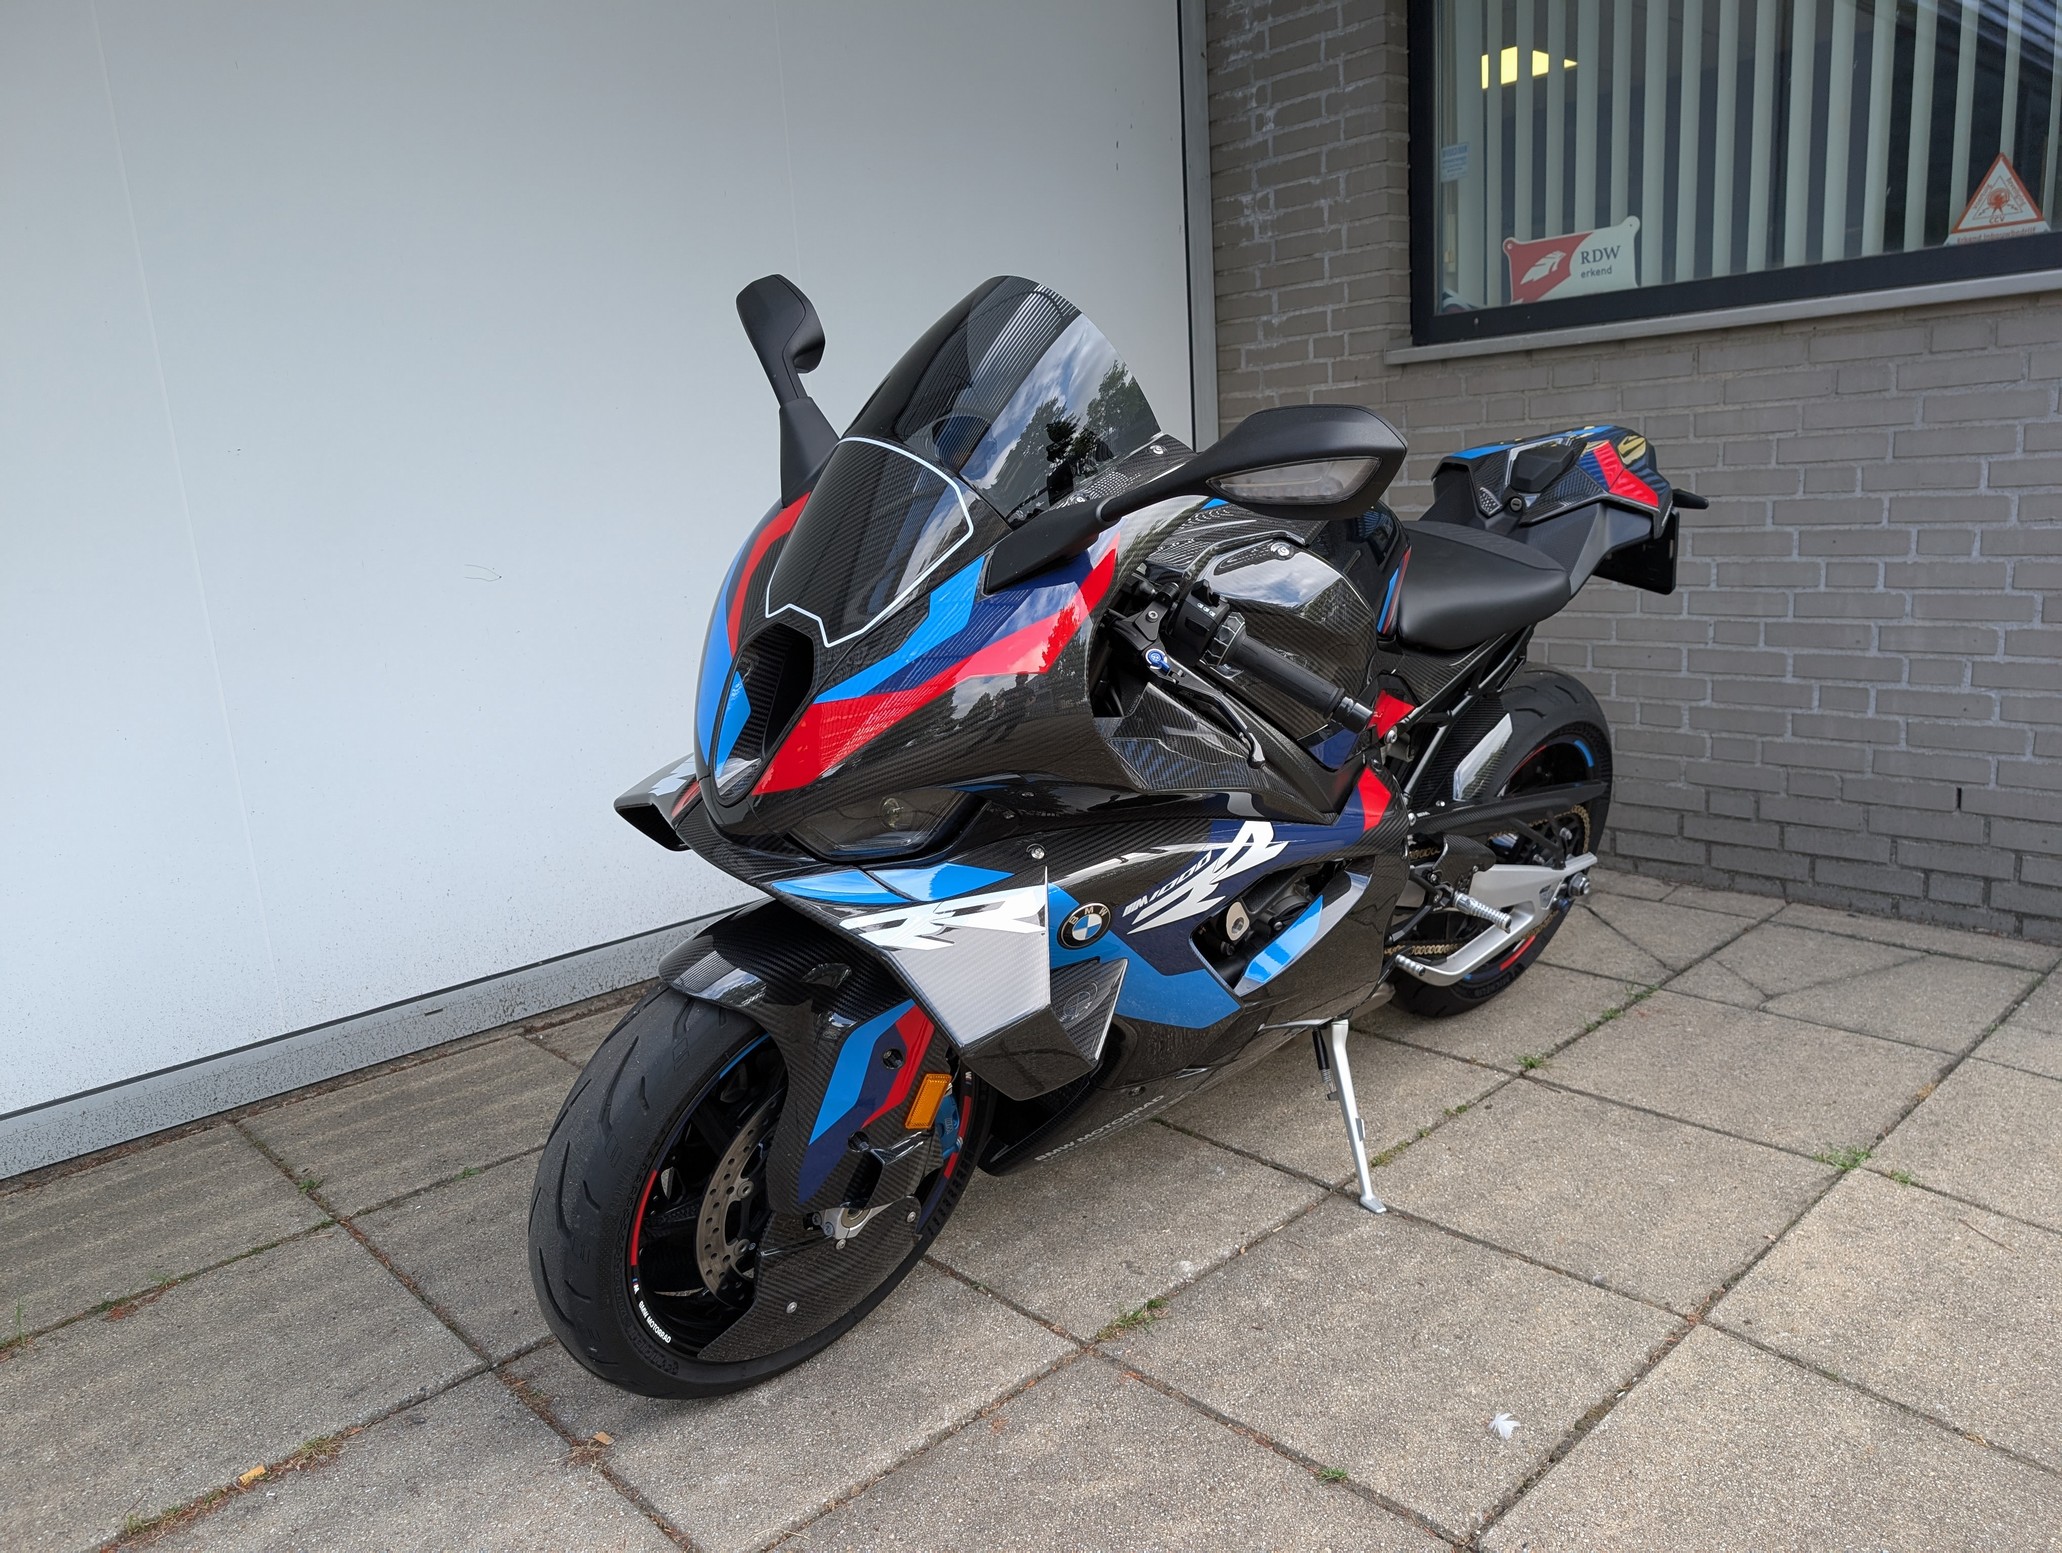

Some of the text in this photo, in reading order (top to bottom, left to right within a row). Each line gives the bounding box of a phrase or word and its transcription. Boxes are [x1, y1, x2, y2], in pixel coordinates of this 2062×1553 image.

[1580, 245, 1621, 265] RDW
[1580, 265, 1613, 279] erkend
[1034, 1095, 1165, 1161] BMW MOTORRAD
[638, 1300, 672, 1344] BMW MOTORRAD
